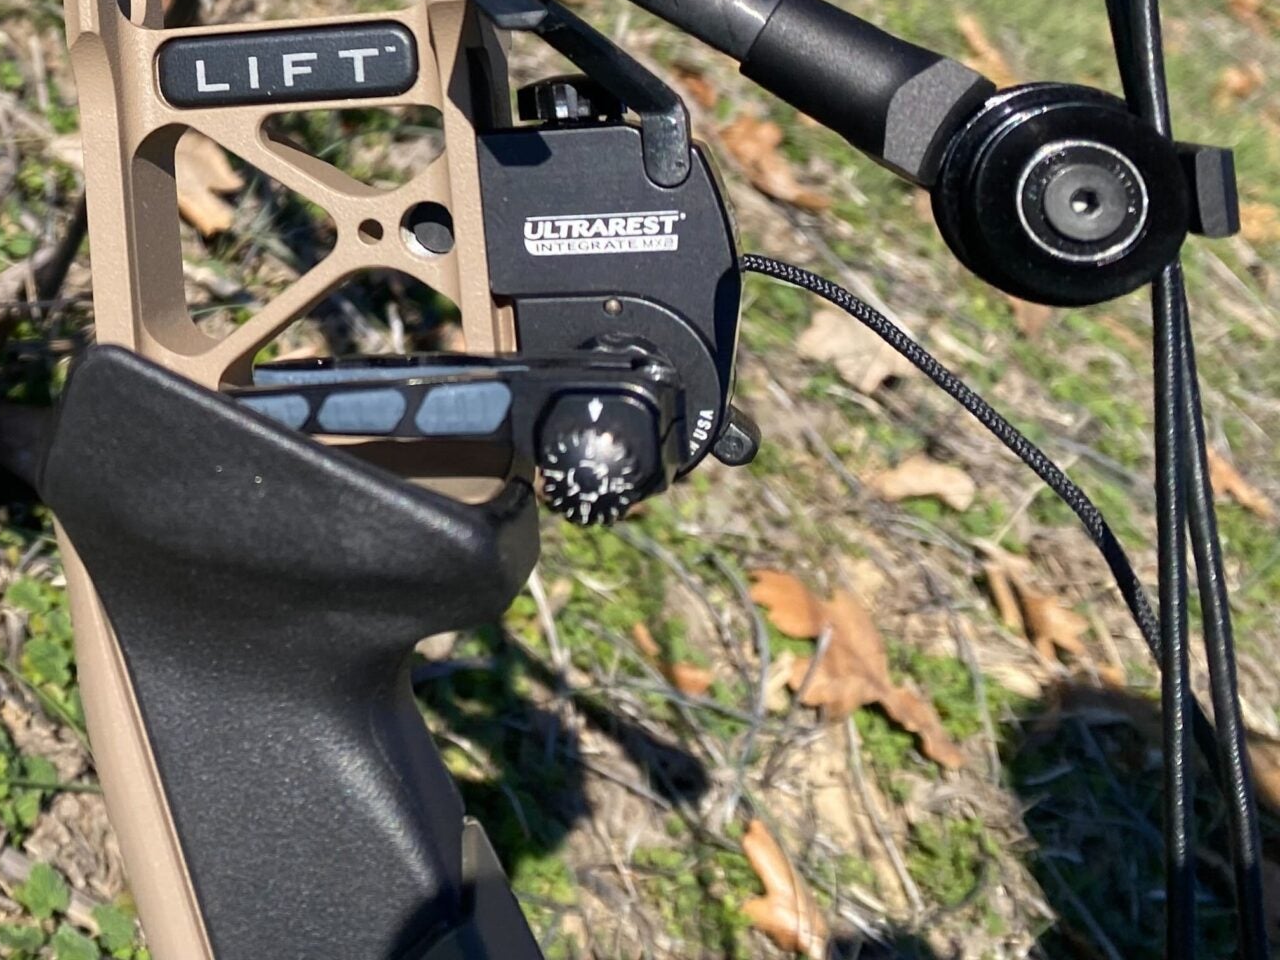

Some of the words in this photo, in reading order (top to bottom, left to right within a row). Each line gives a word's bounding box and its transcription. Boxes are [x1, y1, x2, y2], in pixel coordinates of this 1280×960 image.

[524, 215, 679, 240] ULTRAREST
[535, 239, 638, 253] INTEGRATE
[693, 410, 714, 440] USA
